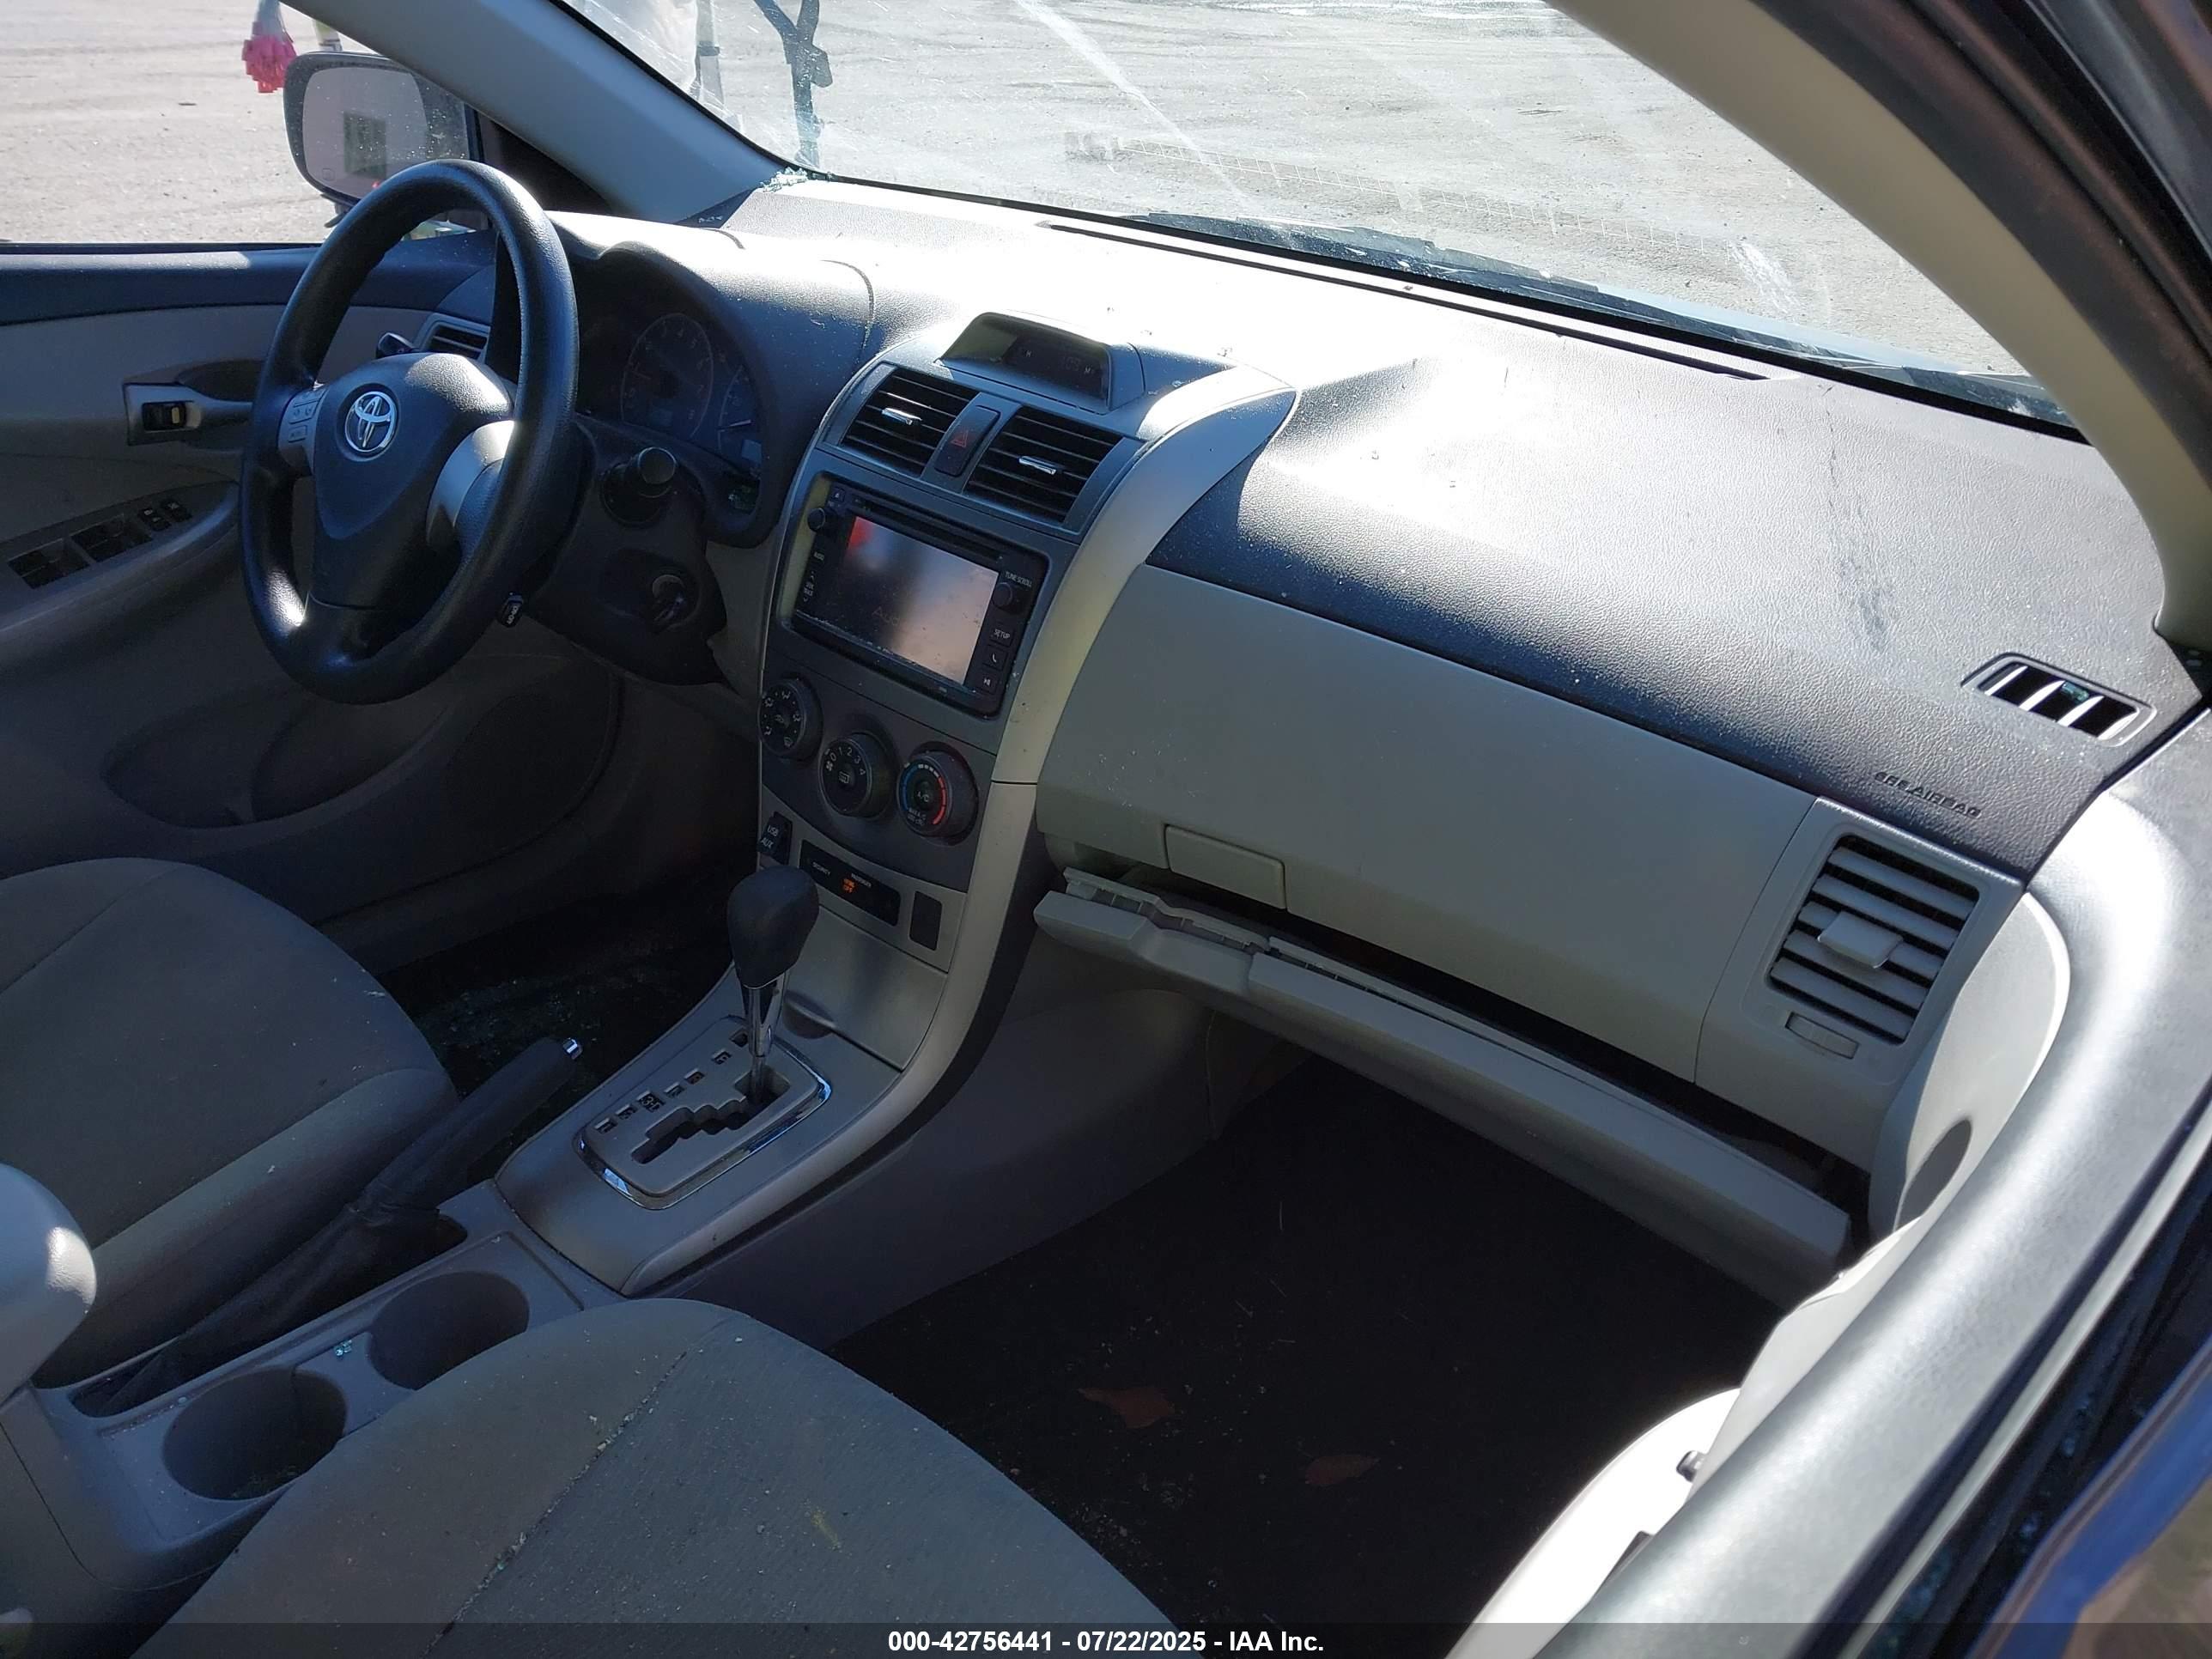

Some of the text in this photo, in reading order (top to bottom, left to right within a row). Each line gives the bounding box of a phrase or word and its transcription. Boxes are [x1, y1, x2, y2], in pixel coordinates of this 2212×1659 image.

[993, 627, 1012, 640] SETUP
[839, 746, 844, 757] 1
[847, 746, 853, 757] 2
[854, 755, 862, 765] 3
[1906, 786, 1982, 818] AIRBAG
[767, 824, 780, 838] USB
[760, 837, 775, 850] AUX
